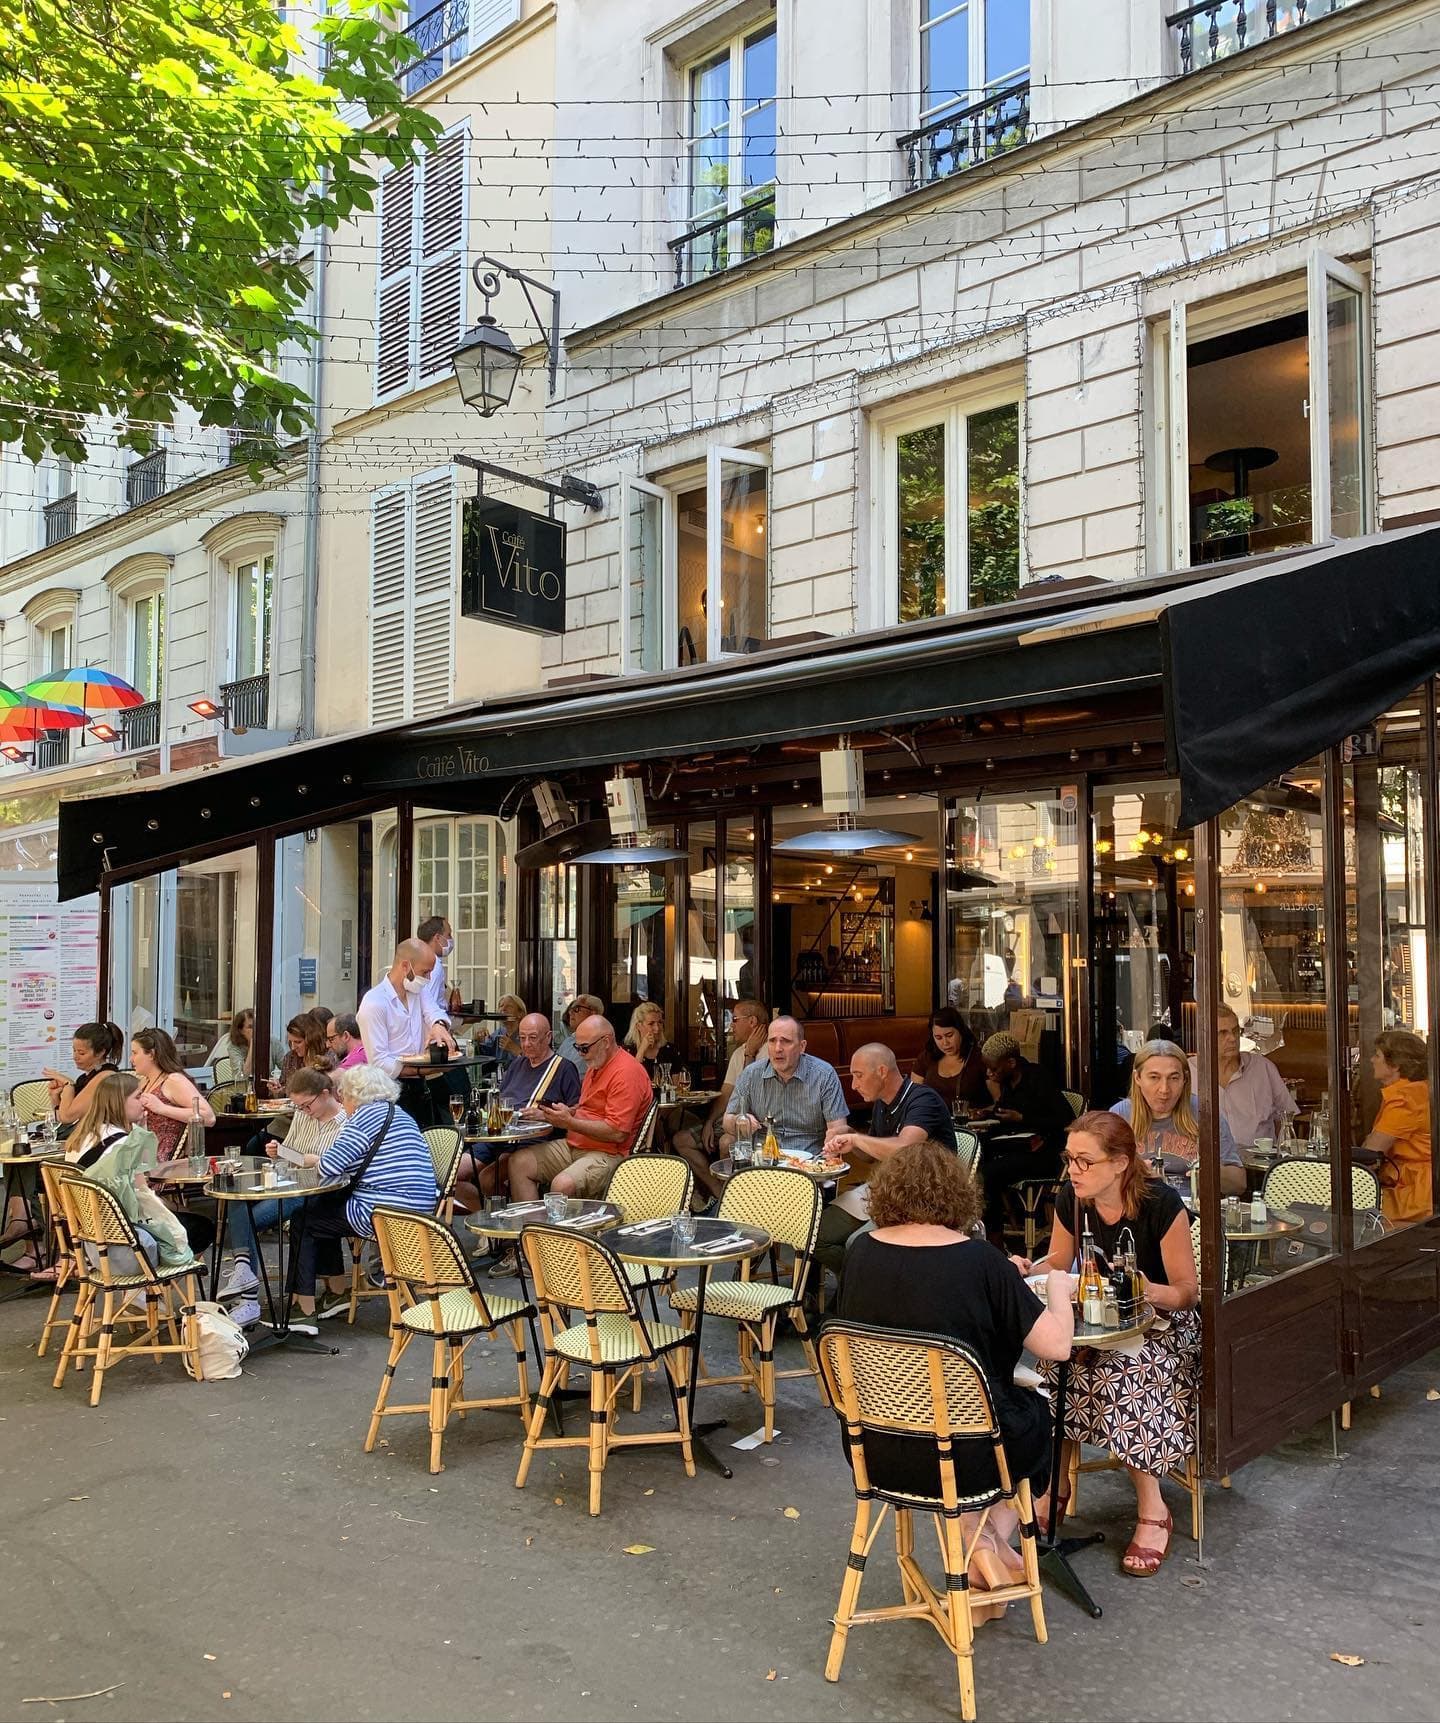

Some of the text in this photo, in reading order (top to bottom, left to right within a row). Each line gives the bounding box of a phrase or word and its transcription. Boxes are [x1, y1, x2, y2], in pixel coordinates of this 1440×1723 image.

[502, 530, 526, 547] Café
[485, 524, 560, 601] Vito
[417, 745, 489, 779] Café Vito
